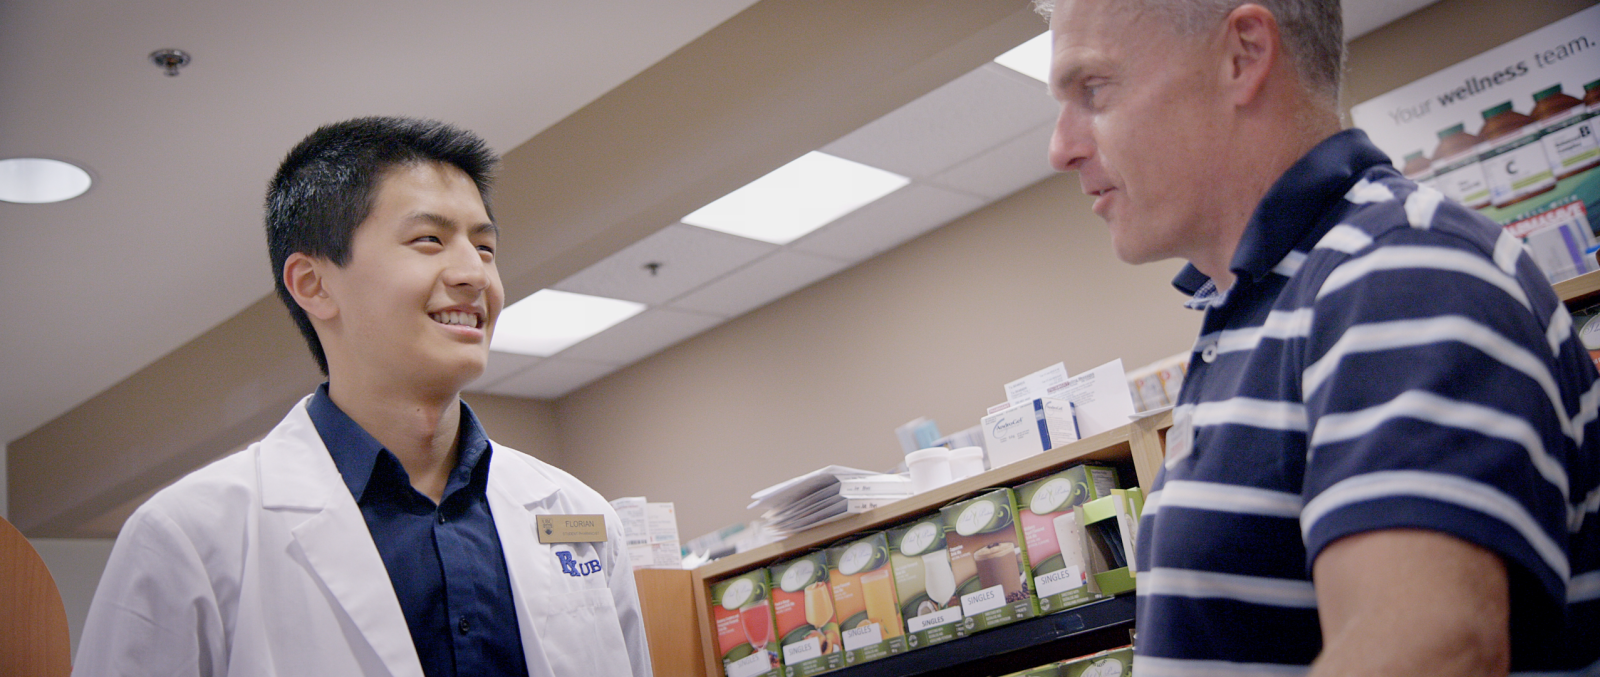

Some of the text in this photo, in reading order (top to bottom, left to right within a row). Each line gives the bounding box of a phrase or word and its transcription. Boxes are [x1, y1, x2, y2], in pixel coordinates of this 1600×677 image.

[1389, 35, 1596, 125] Your wellness team.
[1506, 160, 1519, 175] C
[565, 520, 595, 528] FLORIAN
[1040, 569, 1070, 585] SINGLES
[967, 590, 995, 605] SINGLES
[922, 615, 945, 627] SINGLES
[847, 625, 872, 638] SINGLES
[788, 642, 812, 656] SINGLES
